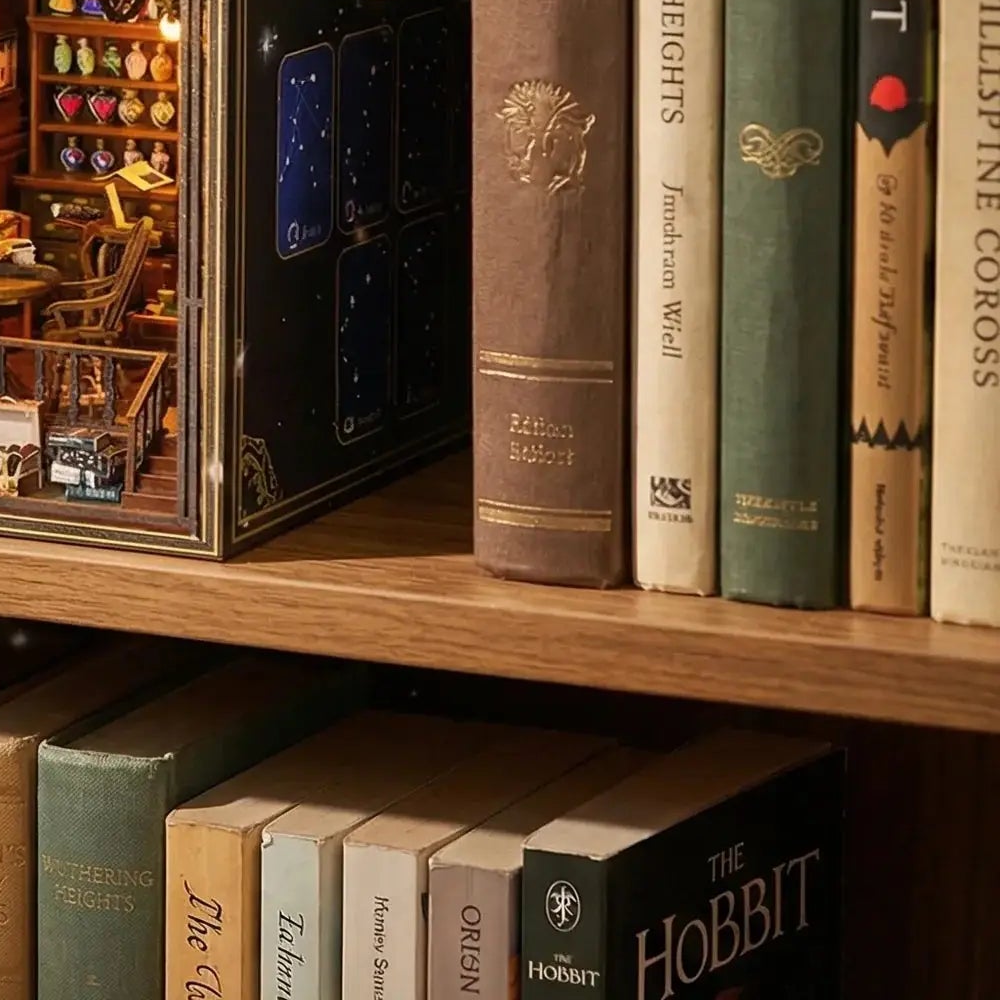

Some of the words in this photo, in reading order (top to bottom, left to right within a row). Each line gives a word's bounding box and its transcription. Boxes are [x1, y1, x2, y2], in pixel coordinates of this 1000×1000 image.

[41, 854, 154, 887] WUTHERING
[707, 842, 745, 882] THE
[184, 880, 223, 952] The
[635, 848, 820, 1000] HOBBIT
[528, 960, 600, 988] HOBBIT
